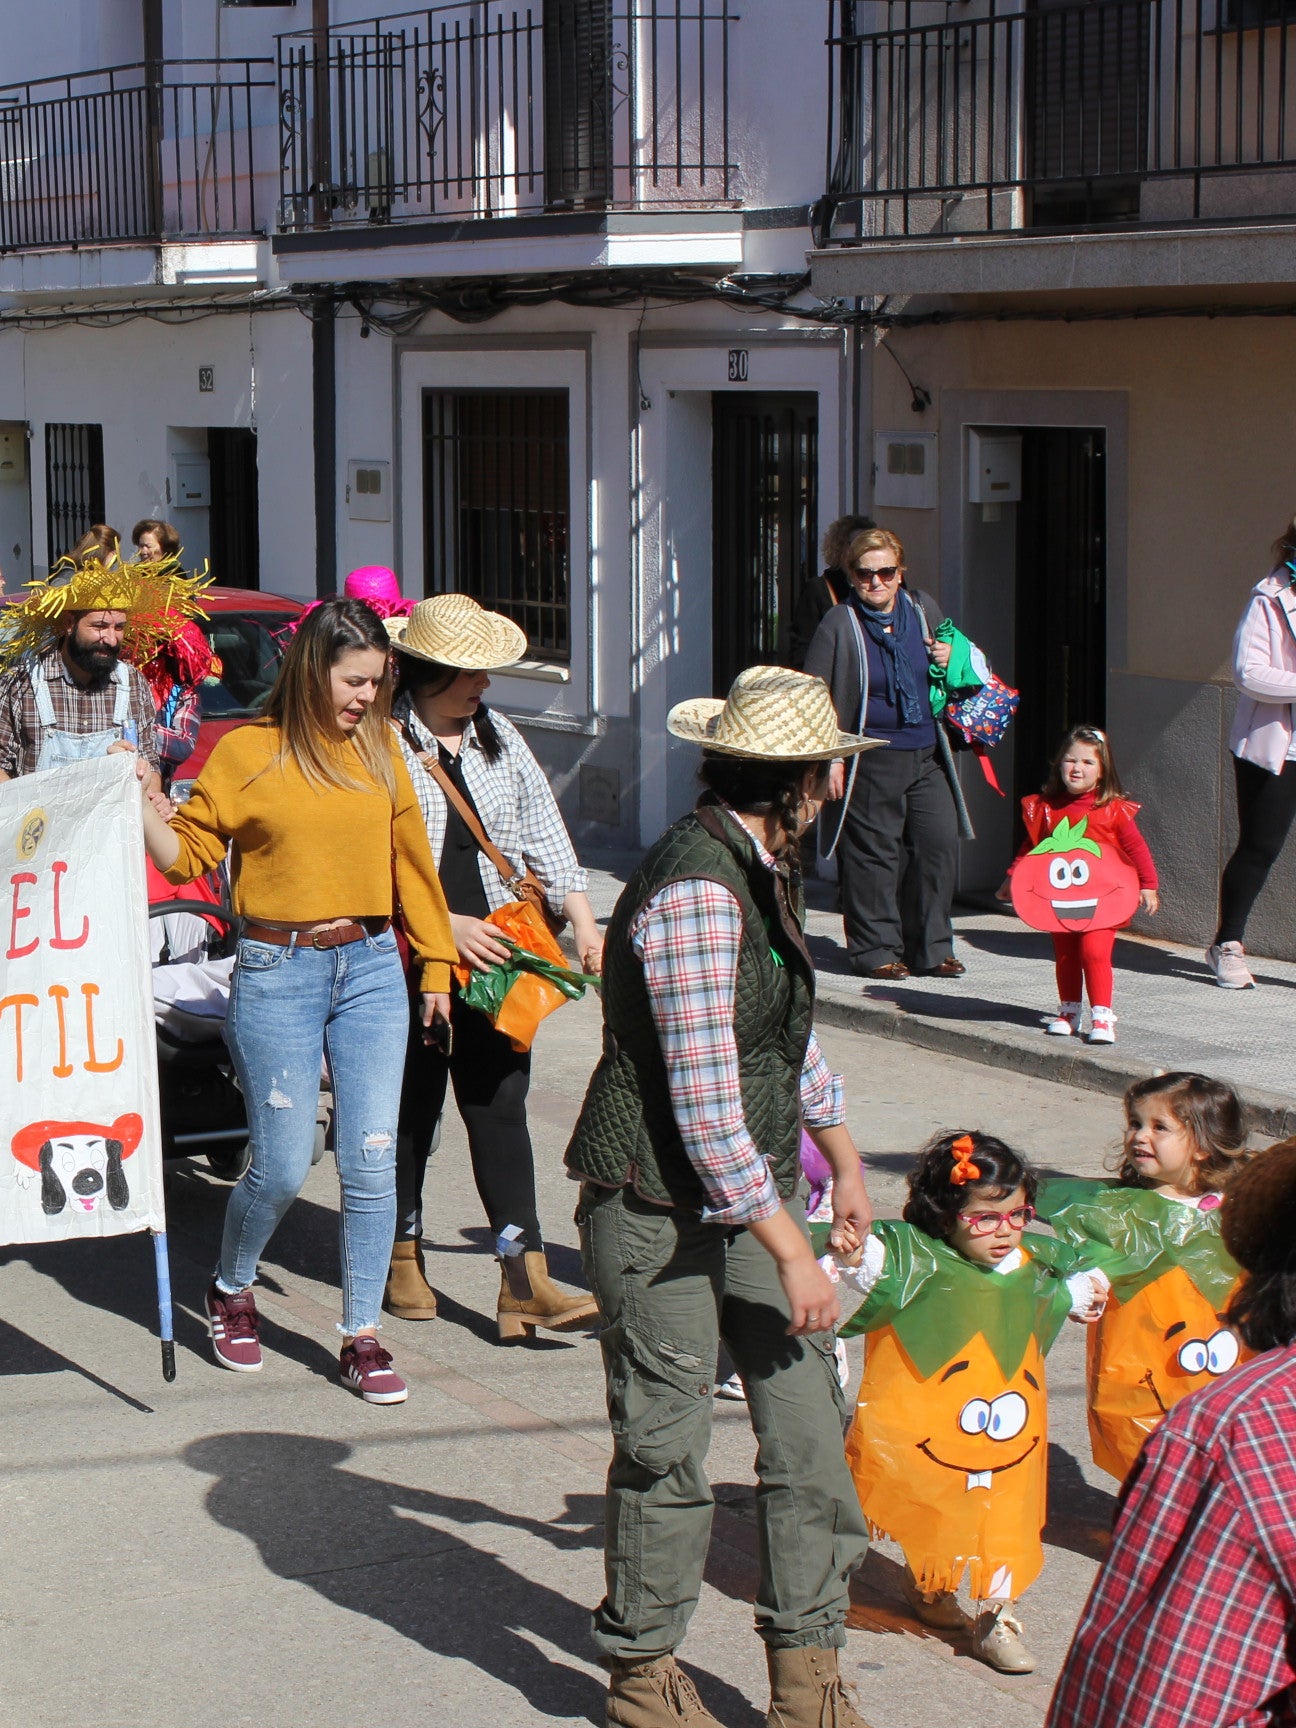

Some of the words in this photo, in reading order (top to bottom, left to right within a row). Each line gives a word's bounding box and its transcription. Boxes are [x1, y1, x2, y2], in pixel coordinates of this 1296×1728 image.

[201, 370, 213, 389] 32
[729, 351, 748, 380] 30
[5, 860, 90, 960] EL
